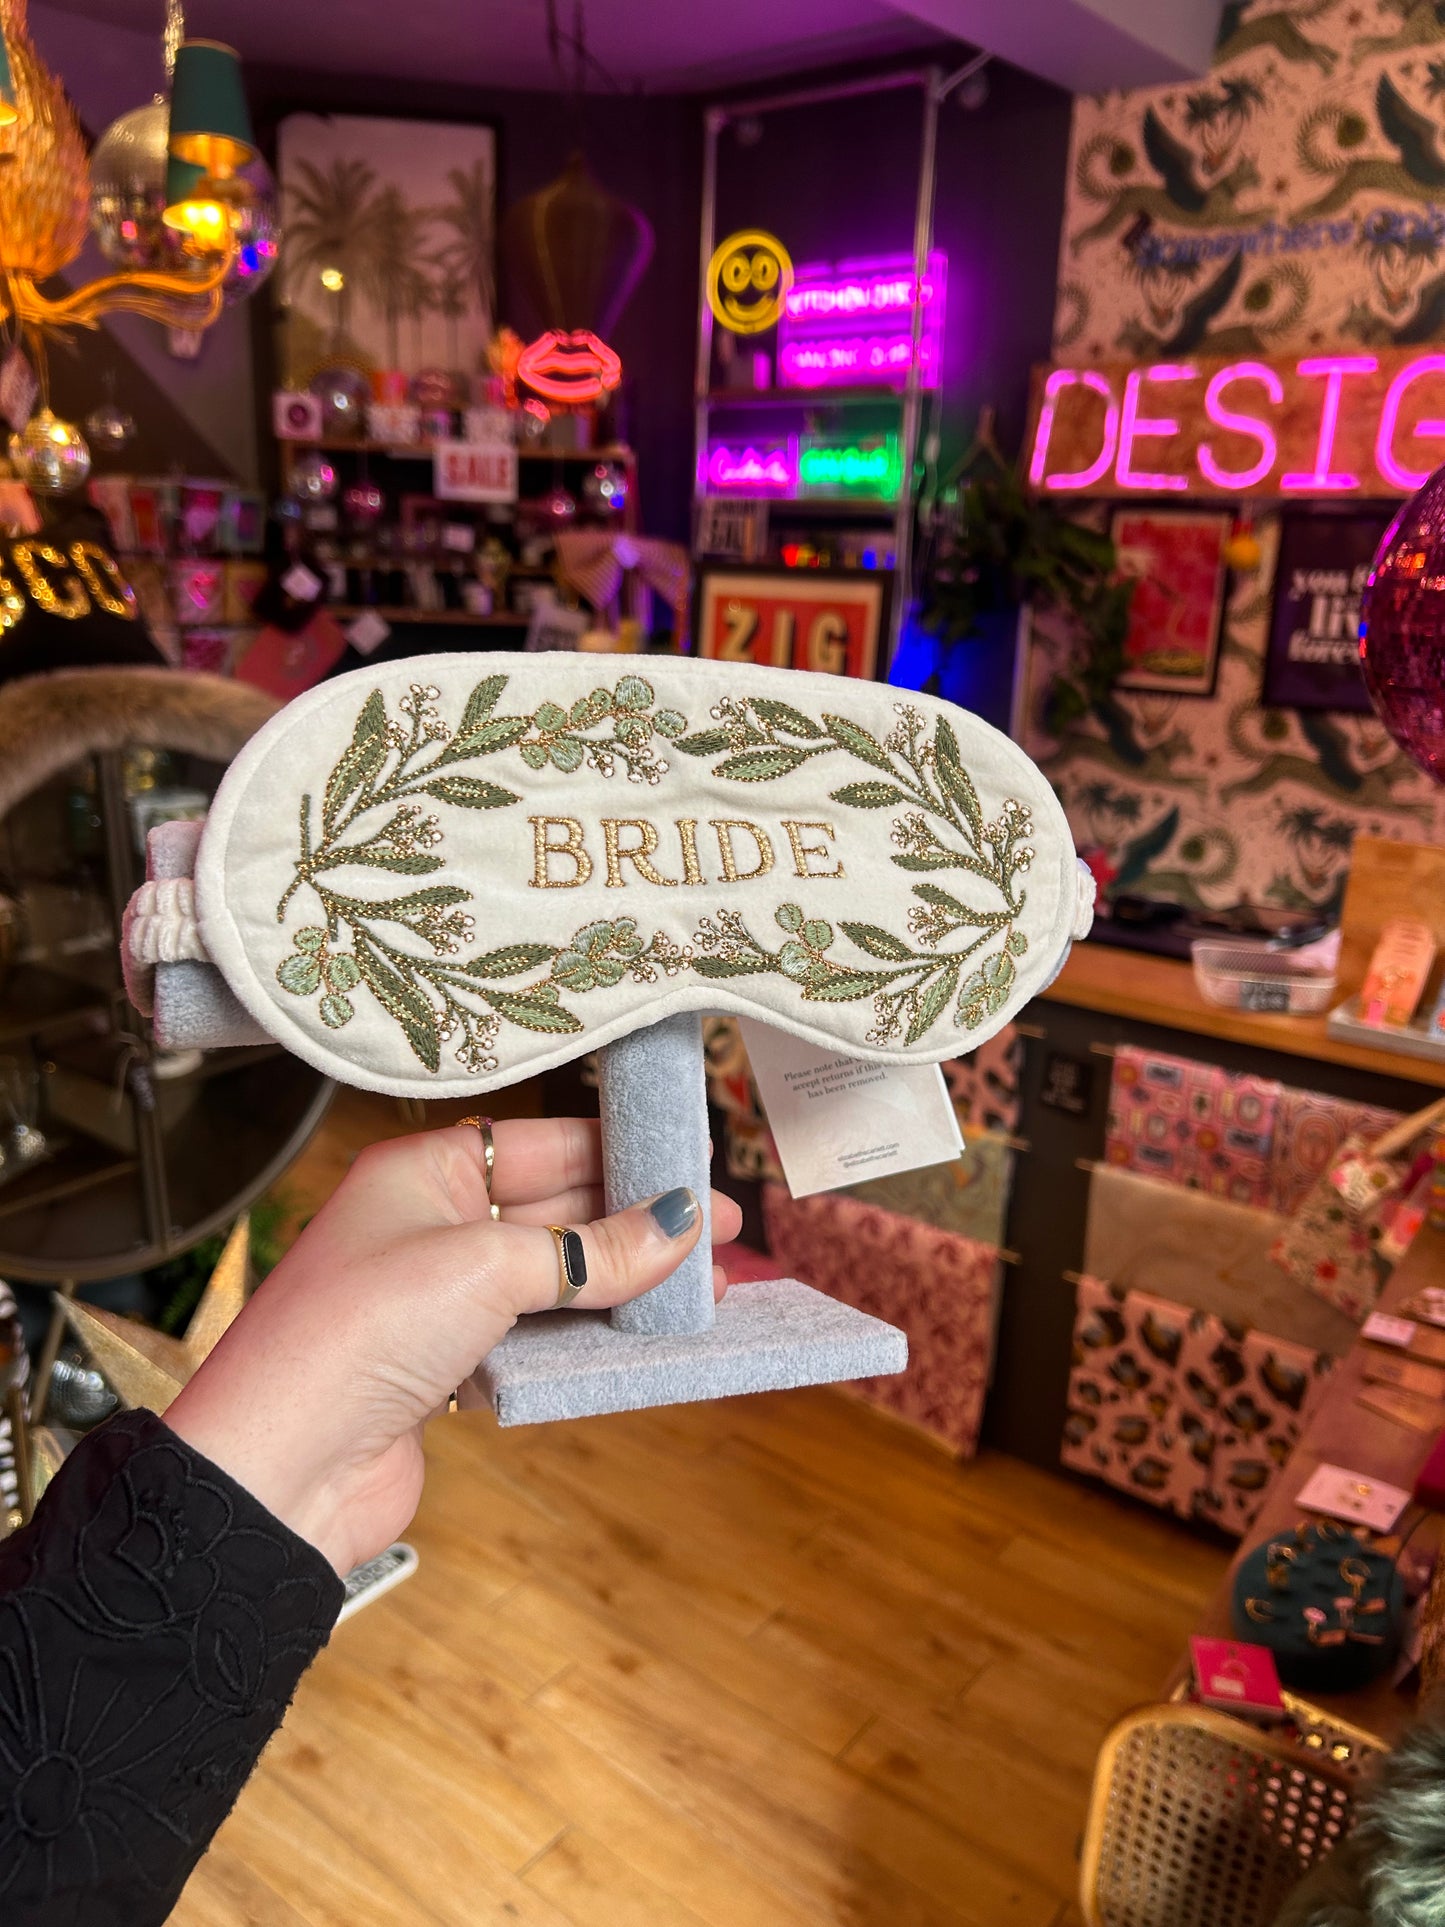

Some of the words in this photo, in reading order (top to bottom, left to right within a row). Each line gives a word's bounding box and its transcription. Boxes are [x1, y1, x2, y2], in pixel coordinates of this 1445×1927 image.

[718, 606, 849, 674] ZIG
[527, 815, 847, 889] BRIDE
[784, 1070, 811, 1082] Please
[814, 1063, 833, 1074] note
[834, 1056, 853, 1068] that
[793, 1078, 820, 1091] accept
[822, 1070, 854, 1084] returns
[855, 1064, 864, 1074] if
[864, 1061, 882, 1073] this
[807, 1090, 824, 1099] has
[824, 1084, 847, 1095] been
[848, 1071, 889, 1089] removed.
